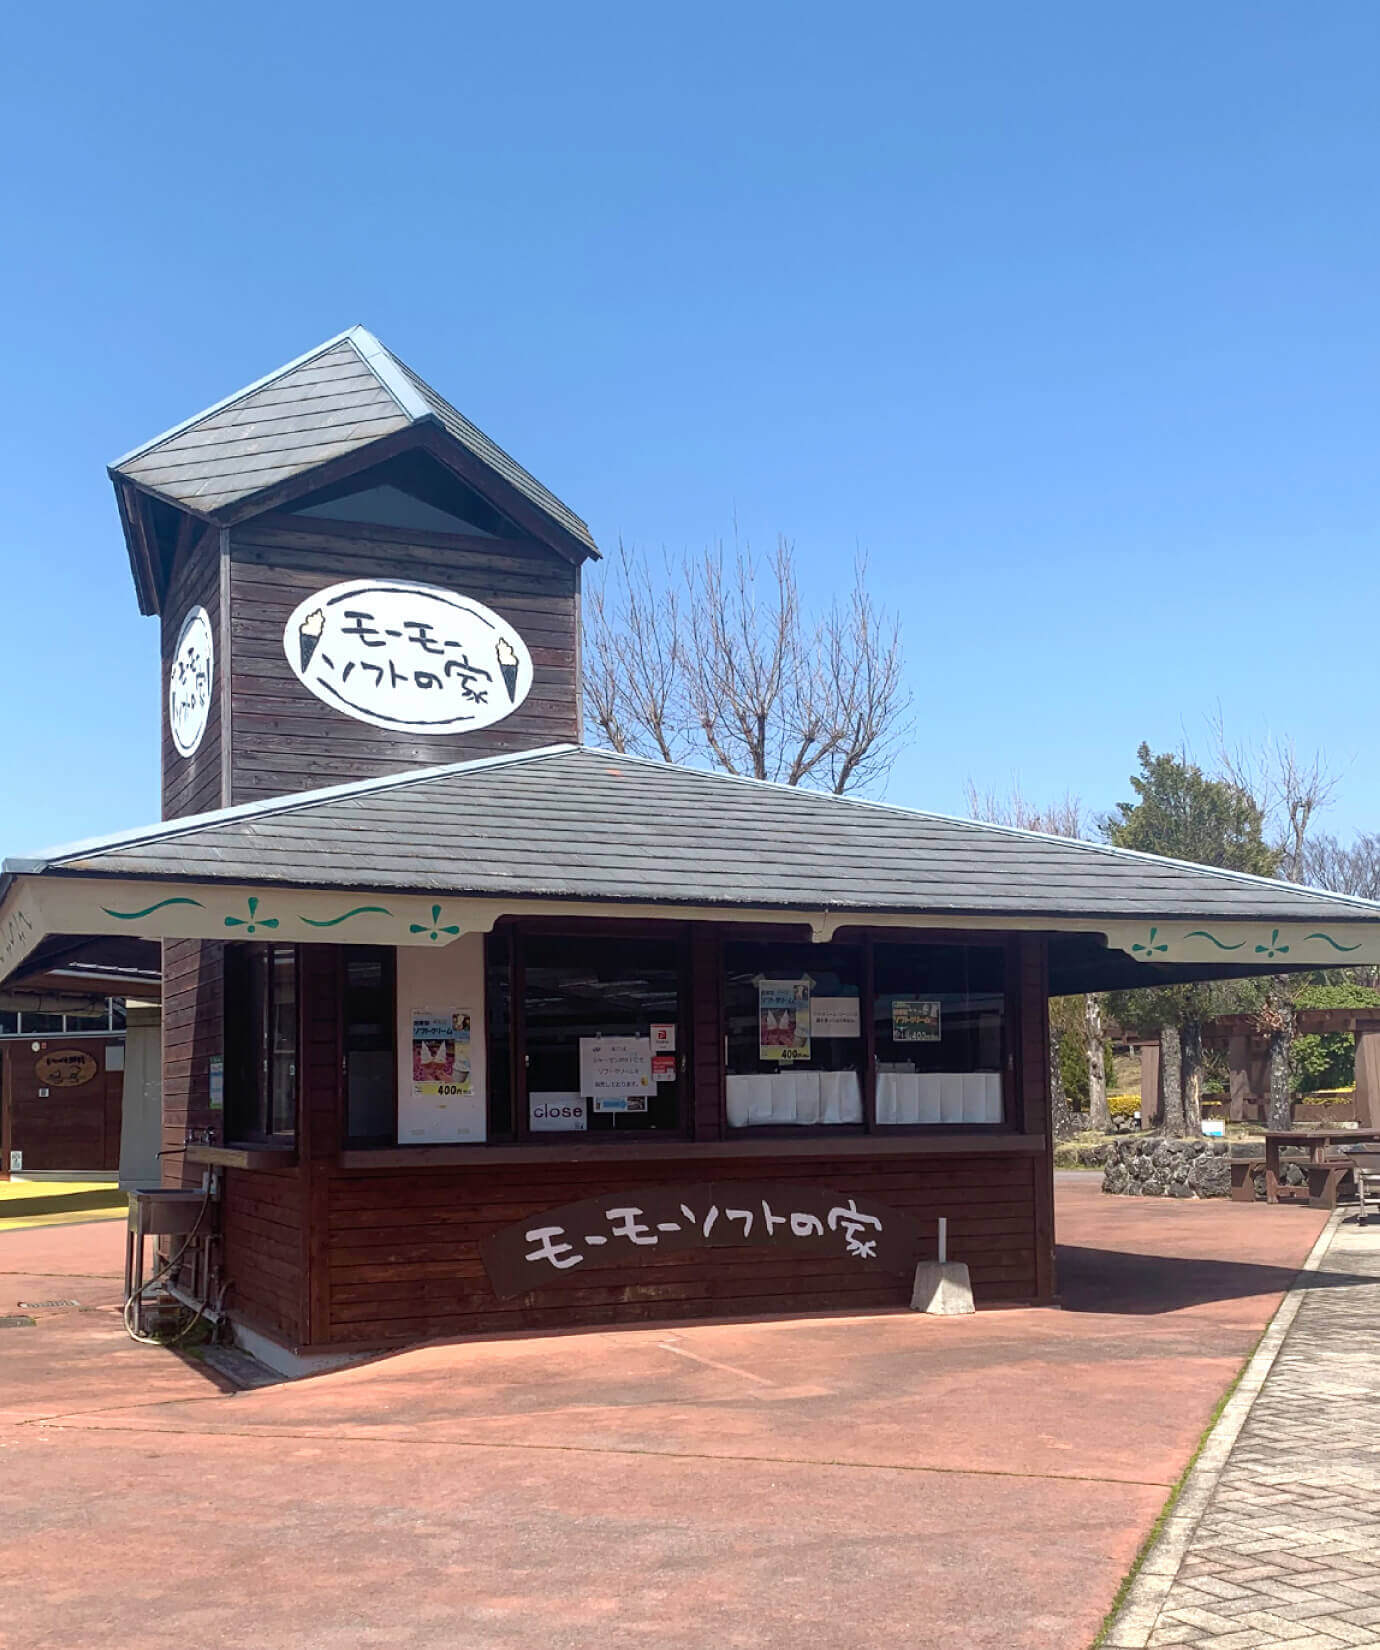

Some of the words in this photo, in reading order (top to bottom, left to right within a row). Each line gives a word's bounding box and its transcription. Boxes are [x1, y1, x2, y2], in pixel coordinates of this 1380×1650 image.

[341, 610, 463, 655] モーモー
[322, 654, 493, 705] ソフトの家
[533, 1103, 583, 1118] close
[524, 1199, 883, 1269] モーモーソフトの家
